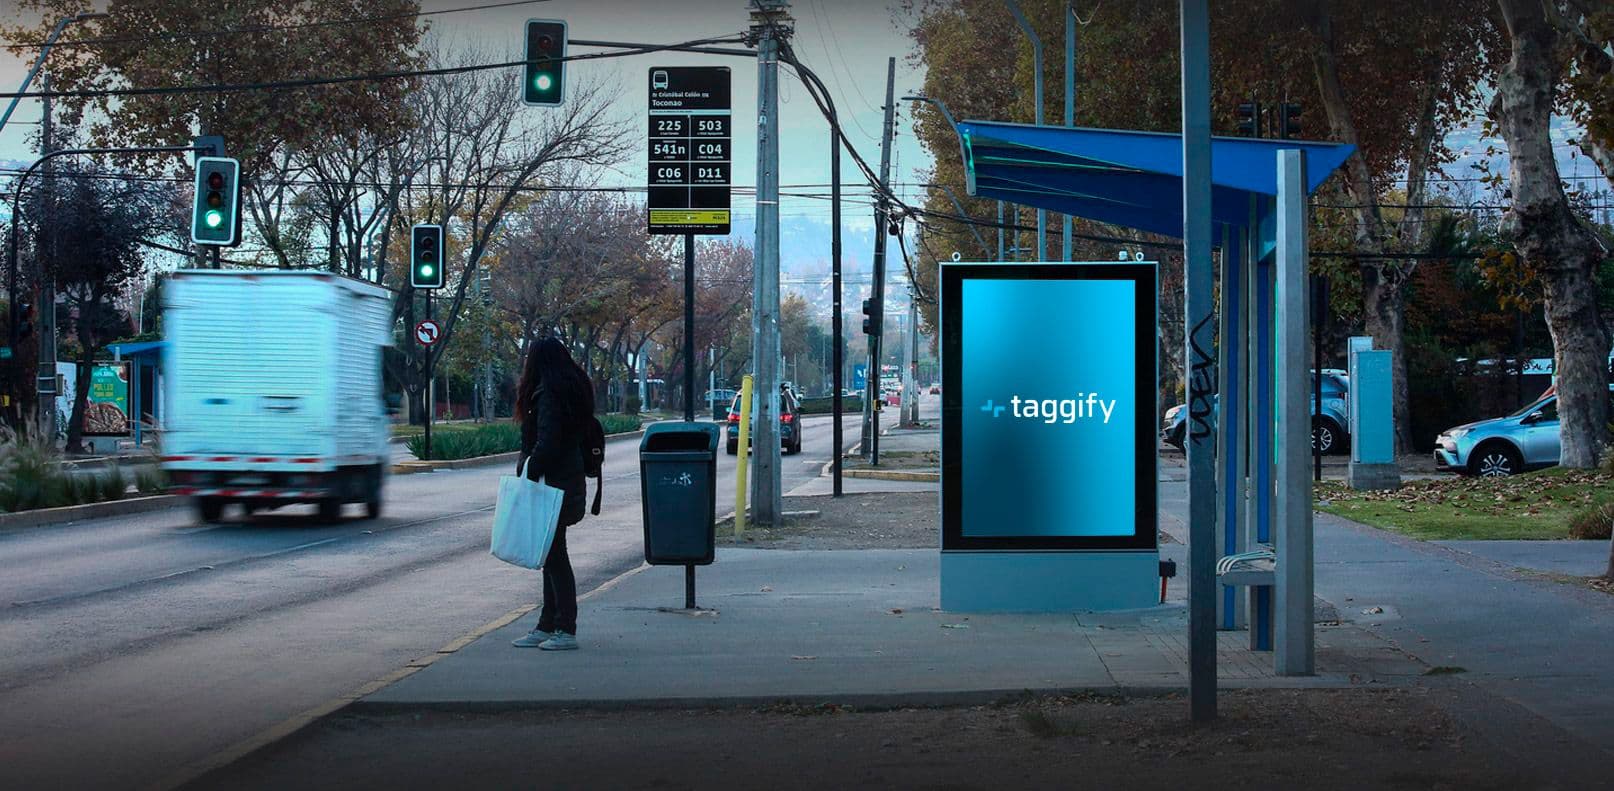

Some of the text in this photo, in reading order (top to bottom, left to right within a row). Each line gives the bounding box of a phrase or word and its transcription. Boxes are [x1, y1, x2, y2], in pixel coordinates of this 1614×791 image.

[658, 120, 681, 131] 225
[698, 120, 722, 131] 503
[654, 144, 685, 154] 541n
[698, 144, 722, 154] C04
[657, 168, 681, 178] C06
[698, 168, 722, 178] D11
[1010, 392, 1116, 424] taggify
